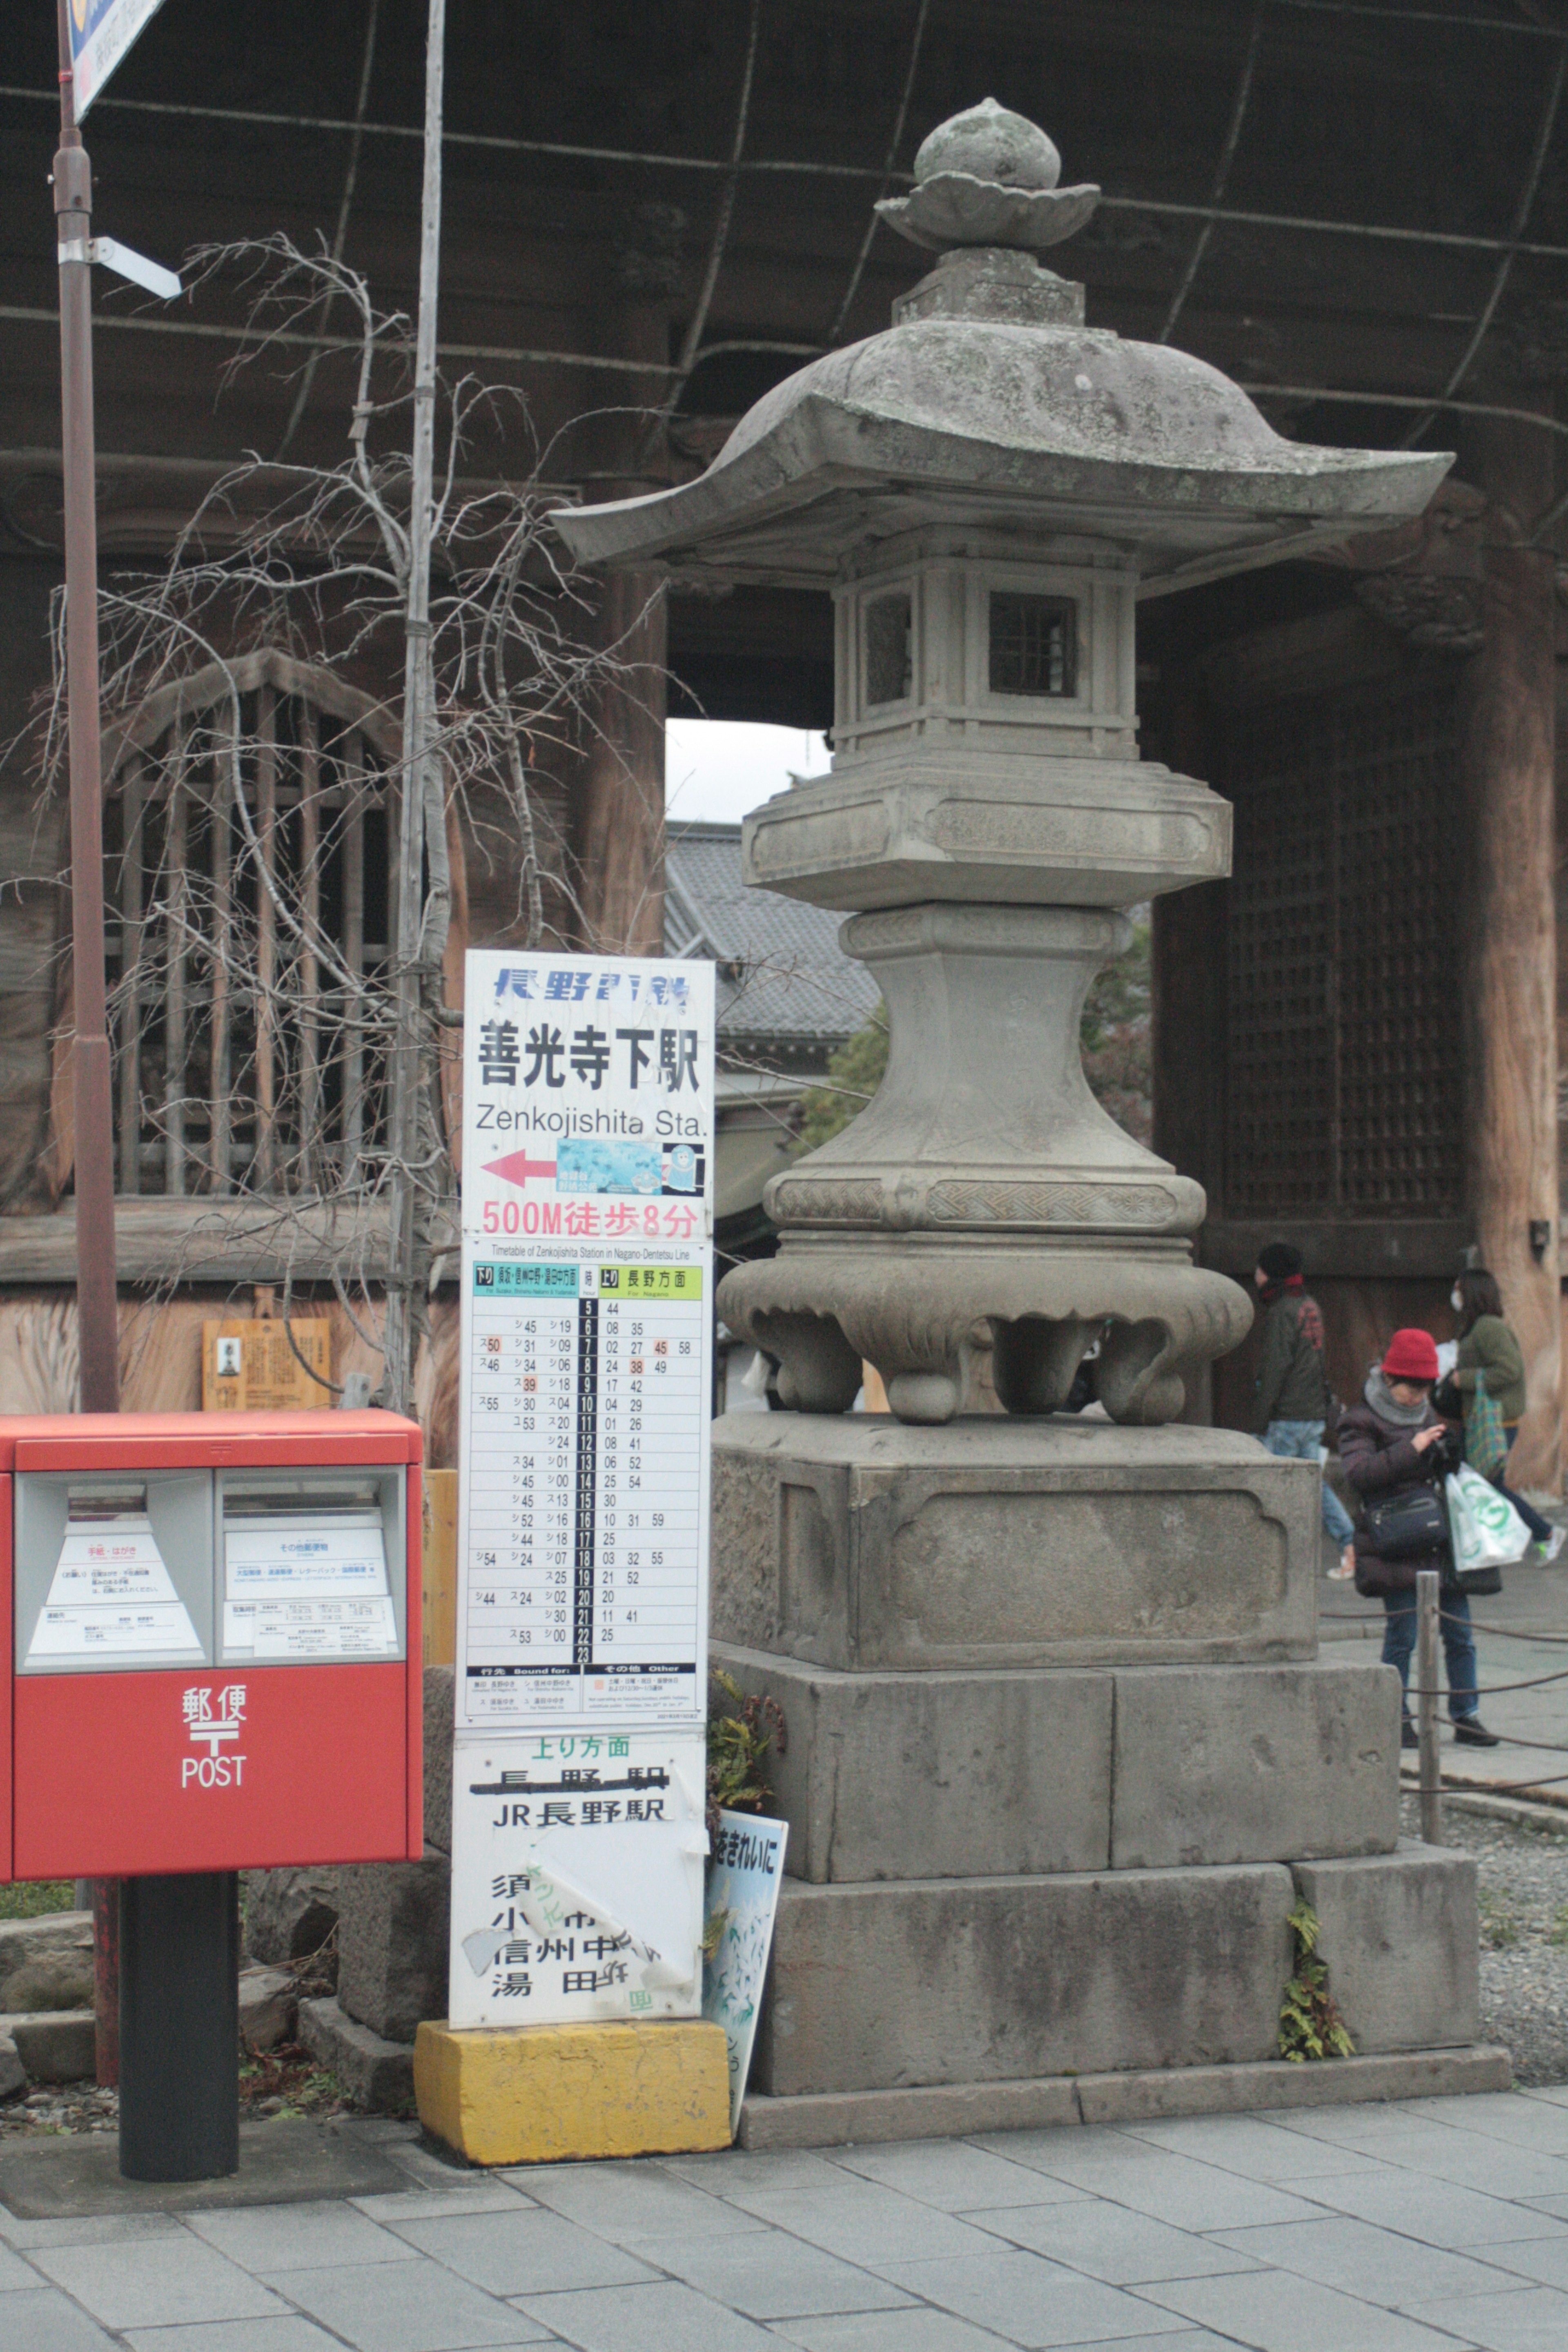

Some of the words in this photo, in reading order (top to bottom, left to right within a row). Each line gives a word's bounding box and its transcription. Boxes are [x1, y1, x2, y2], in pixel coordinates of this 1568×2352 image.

[478, 1018, 699, 1093] 善光寺下駅
[476, 1104, 644, 1139] Zenkojishita
[655, 1110, 707, 1136] Sta.
[492, 1245, 526, 1256] Timetable
[528, 1247, 534, 1256] of
[537, 1245, 577, 1259] Zenkojishita
[580, 1247, 604, 1258] Station
[606, 1248, 612, 1258] in
[615, 1248, 673, 1261] Nagano-Dentetsu
[675, 1250, 690, 1260] Line
[477, 1267, 492, 1284] 下り
[584, 1271, 592, 1286] 時
[602, 1270, 617, 1286] 上り
[585, 1301, 591, 1314] 5
[607, 1303, 618, 1314] 44
[585, 1320, 591, 1333] 6
[607, 1322, 618, 1334] 08
[631, 1323, 643, 1335] 35
[585, 1339, 591, 1352] 7
[606, 1341, 618, 1354] 02
[631, 1342, 642, 1354] 27
[655, 1342, 666, 1354] 45
[679, 1341, 690, 1354] 58
[585, 1359, 591, 1372] 8
[606, 1360, 618, 1372] 24
[631, 1361, 642, 1374] 38
[655, 1361, 666, 1373] 49
[584, 1378, 590, 1392] 9
[607, 1379, 617, 1391] 17
[630, 1380, 641, 1393] 42
[582, 1397, 592, 1411] 10
[606, 1398, 617, 1411] 04
[630, 1399, 642, 1412] 29
[582, 1417, 591, 1431] 11
[605, 1417, 615, 1430] 01
[630, 1418, 641, 1430] 26
[581, 1436, 592, 1450] 12
[605, 1437, 617, 1449] 08
[630, 1438, 639, 1450] 41
[581, 1455, 592, 1469] 13
[605, 1456, 616, 1468] 06
[629, 1457, 641, 1470] 52
[581, 1474, 591, 1488] 14
[604, 1475, 616, 1488] 25
[629, 1476, 640, 1488] 54
[580, 1493, 591, 1508] 15
[604, 1494, 615, 1507] 30
[580, 1512, 590, 1527] 16
[604, 1513, 615, 1526] 10
[628, 1514, 638, 1527] 31
[653, 1514, 664, 1526] 59
[580, 1532, 590, 1546] 17
[603, 1532, 615, 1546] 25
[579, 1551, 590, 1566] 18
[603, 1552, 614, 1565] 03
[628, 1552, 639, 1565] 32
[652, 1552, 662, 1565] 55
[579, 1570, 590, 1584] 19
[603, 1571, 612, 1584] 21
[628, 1572, 639, 1584] 52
[579, 1590, 590, 1605] 20
[602, 1590, 614, 1603] 20
[579, 1610, 589, 1625] 21
[602, 1610, 612, 1622] 11
[626, 1611, 637, 1622] 41
[578, 1628, 588, 1644] 22
[601, 1628, 613, 1642] 25
[578, 1647, 588, 1661] 23
[182, 1685, 246, 1723] 郵便
[532, 1736, 630, 1759] 上り方面
[181, 1756, 246, 1788] POST
[493, 1799, 665, 1827] JR長野駅
